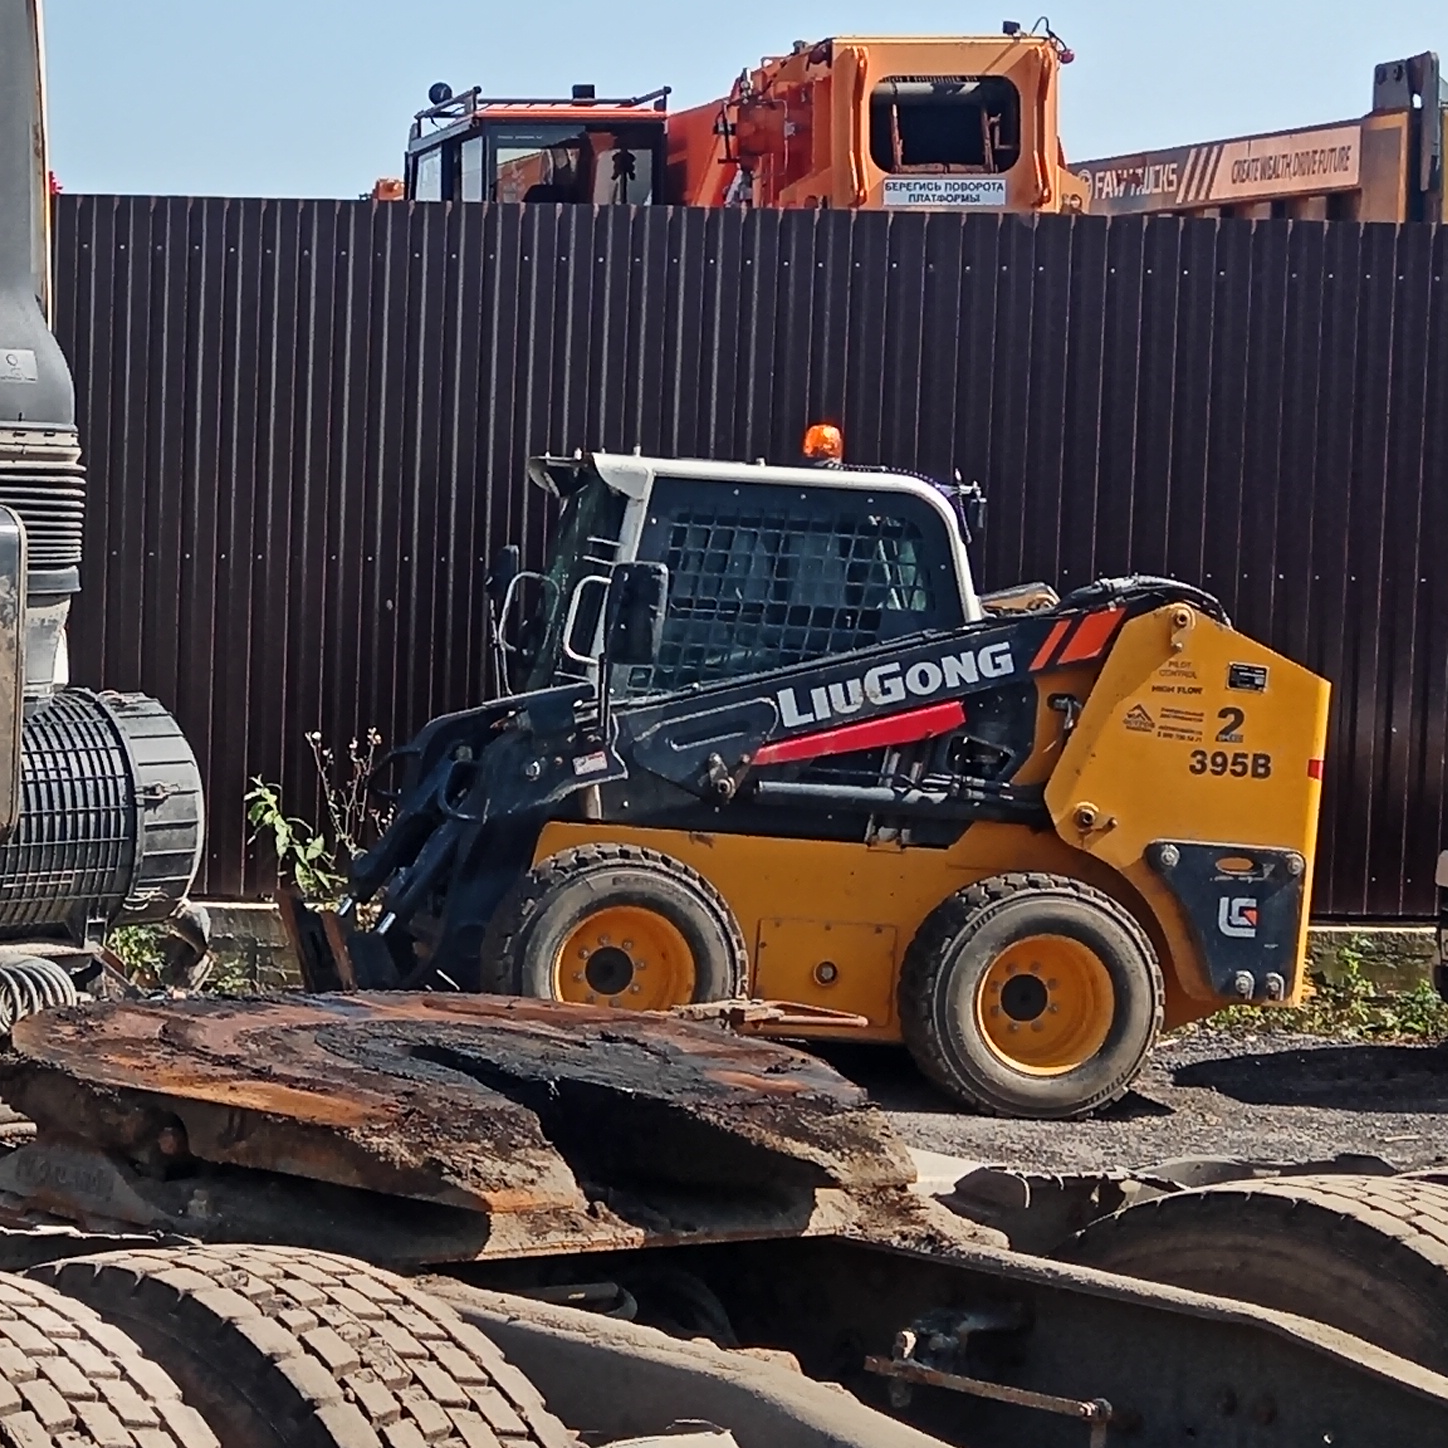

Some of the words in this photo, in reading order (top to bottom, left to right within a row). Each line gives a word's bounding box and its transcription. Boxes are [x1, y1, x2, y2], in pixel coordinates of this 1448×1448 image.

[885, 181, 942, 192] БЕРЕГИСЬ
[944, 181, 1004, 192] ПОВОРОТА
[908, 193, 981, 203] ПЛАТФОРМЫ
[1094, 169, 1128, 200] FAW
[1215, 706, 1245, 743] 2
[1189, 749, 1272, 780] 395B
